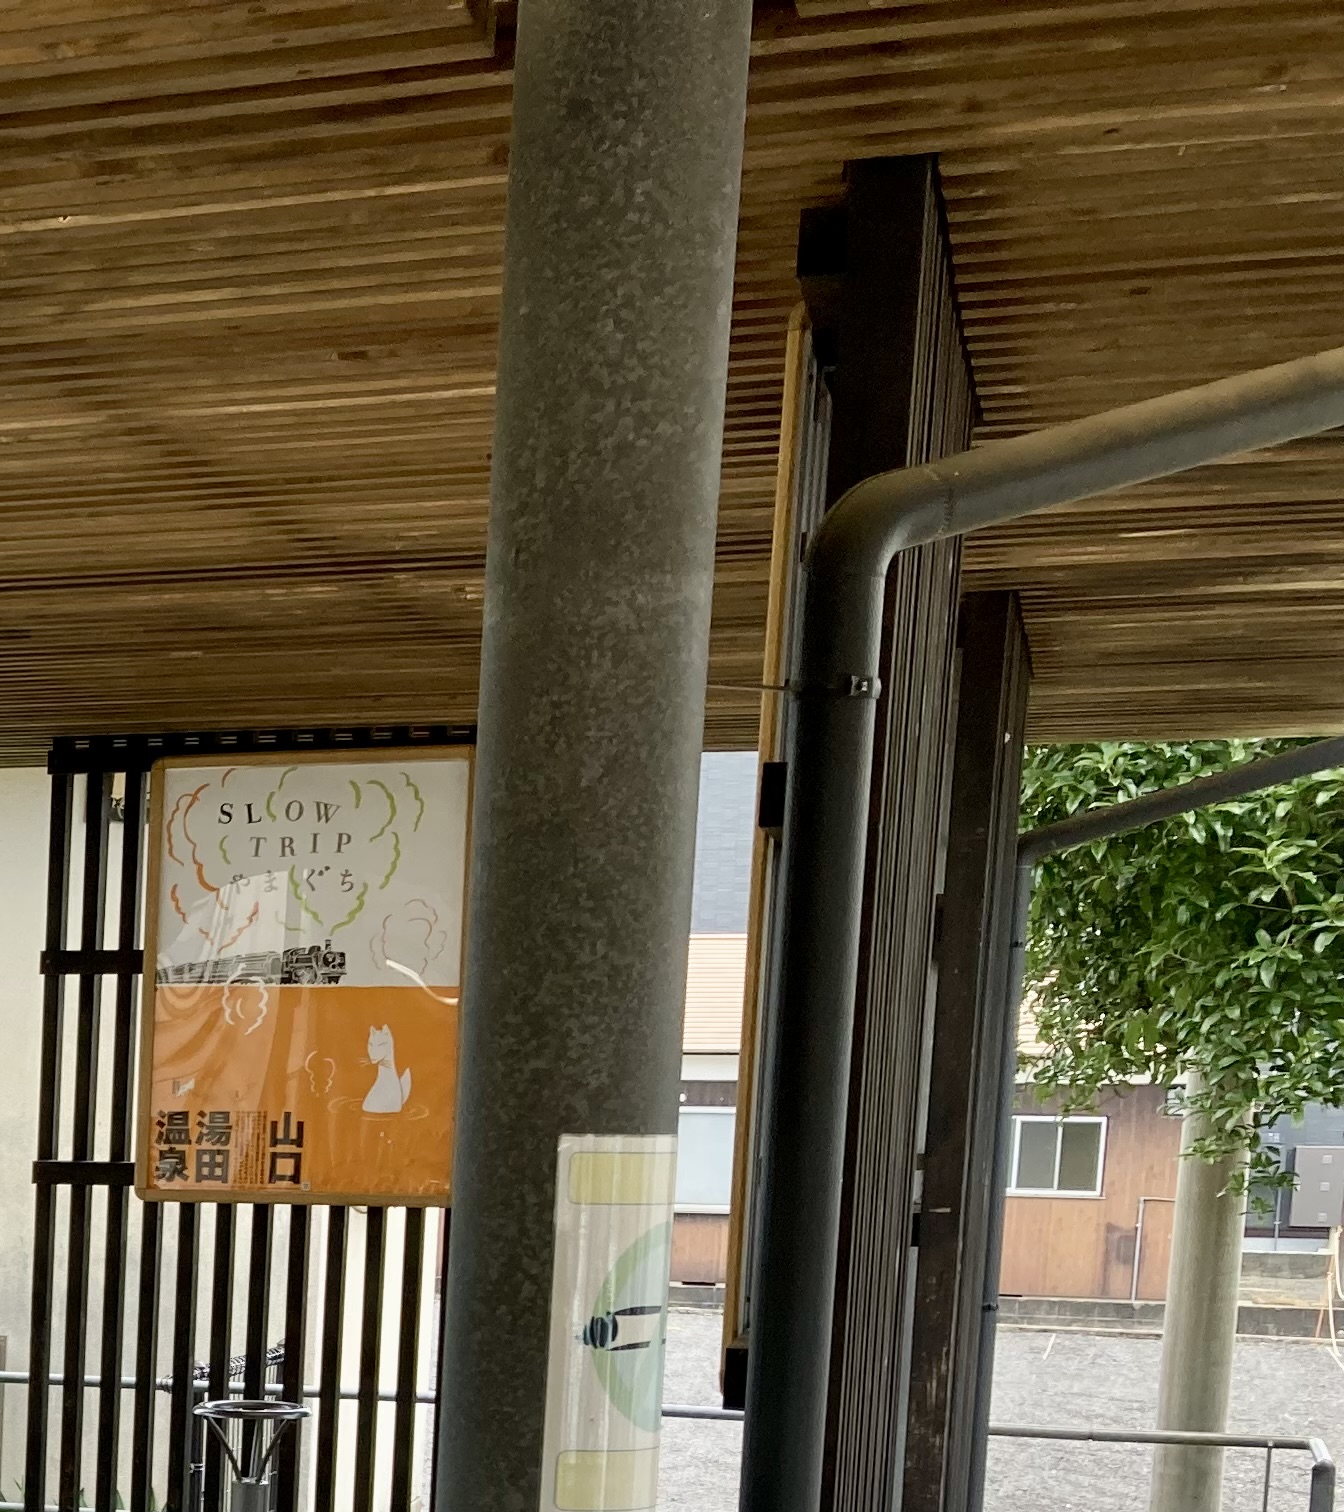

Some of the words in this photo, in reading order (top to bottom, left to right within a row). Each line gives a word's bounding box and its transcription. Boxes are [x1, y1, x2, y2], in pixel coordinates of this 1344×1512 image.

[218, 800, 341, 824] SLOW
[249, 832, 352, 857] TRIP
[230, 865, 354, 893] やまぐち
[155, 1110, 192, 1182] 温泉
[195, 1110, 233, 1183] 湯田
[269, 1111, 305, 1185] 山口
